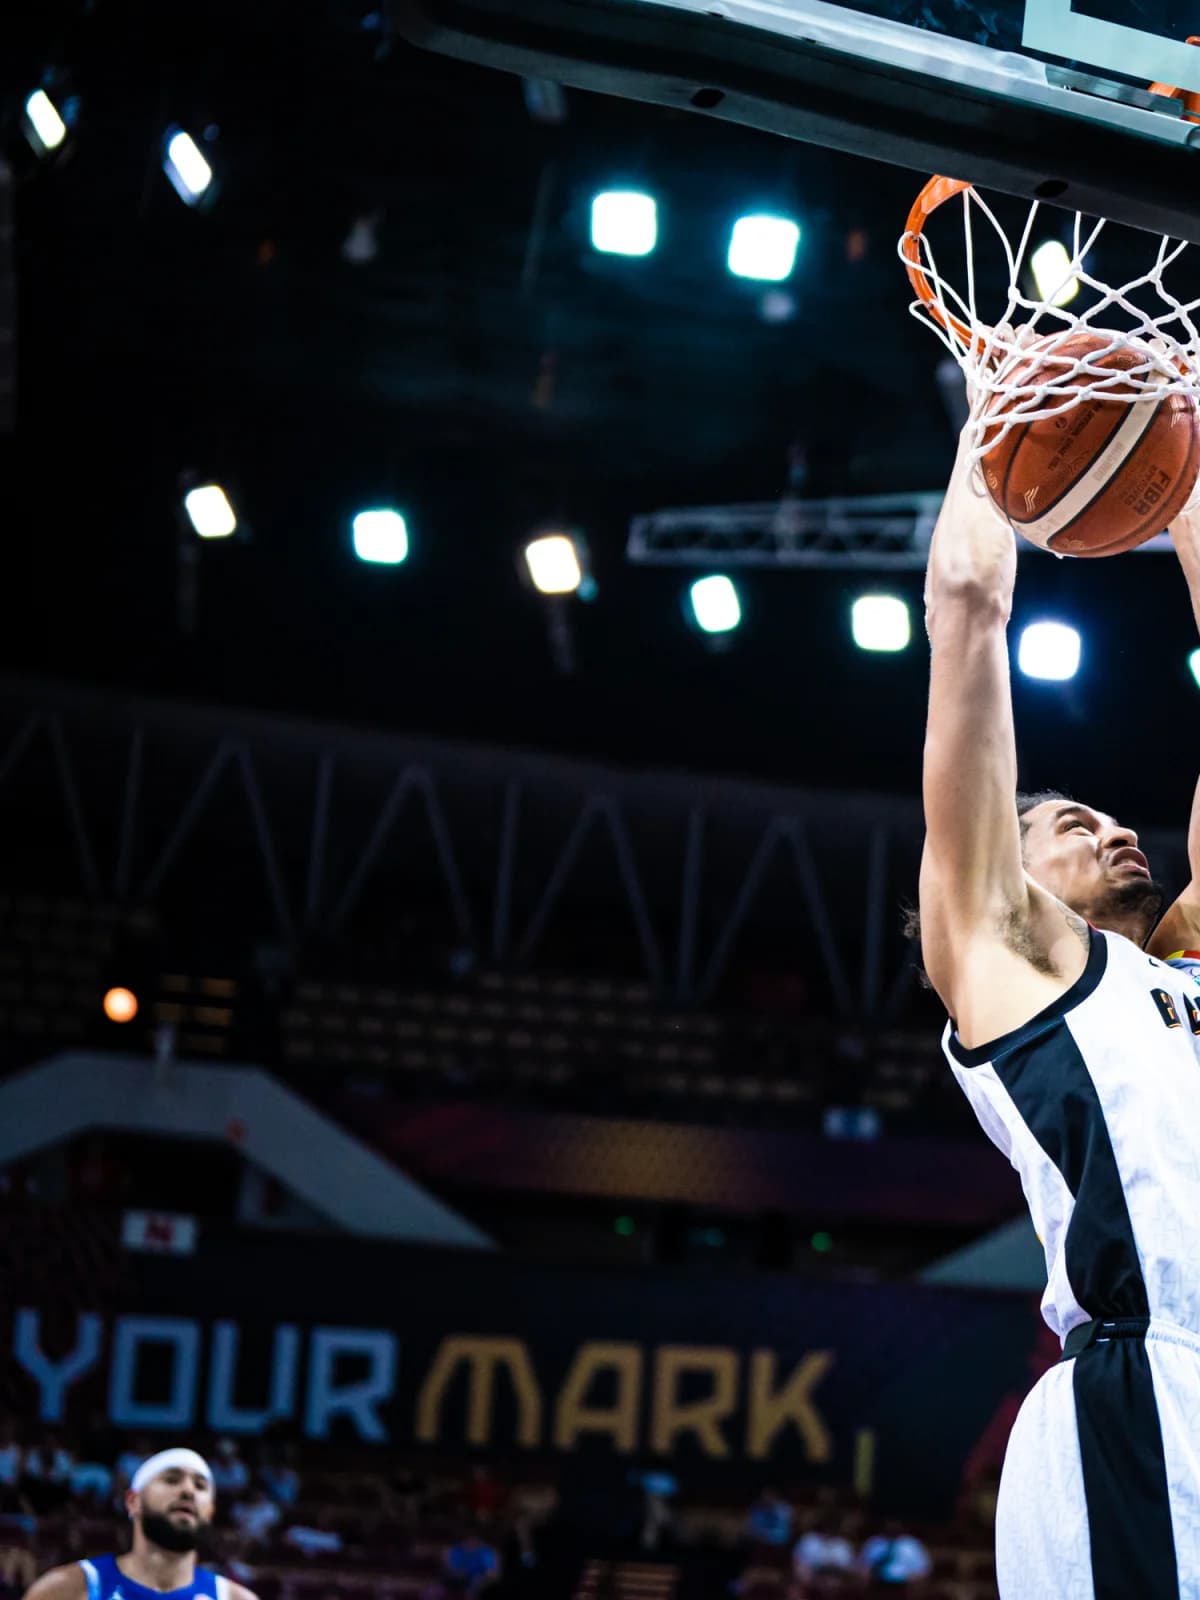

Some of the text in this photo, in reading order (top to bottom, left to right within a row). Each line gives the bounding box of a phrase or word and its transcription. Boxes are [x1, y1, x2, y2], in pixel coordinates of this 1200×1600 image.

[1133, 470, 1171, 516] FIBA
[11, 1308, 835, 1464] YOUR MARK
